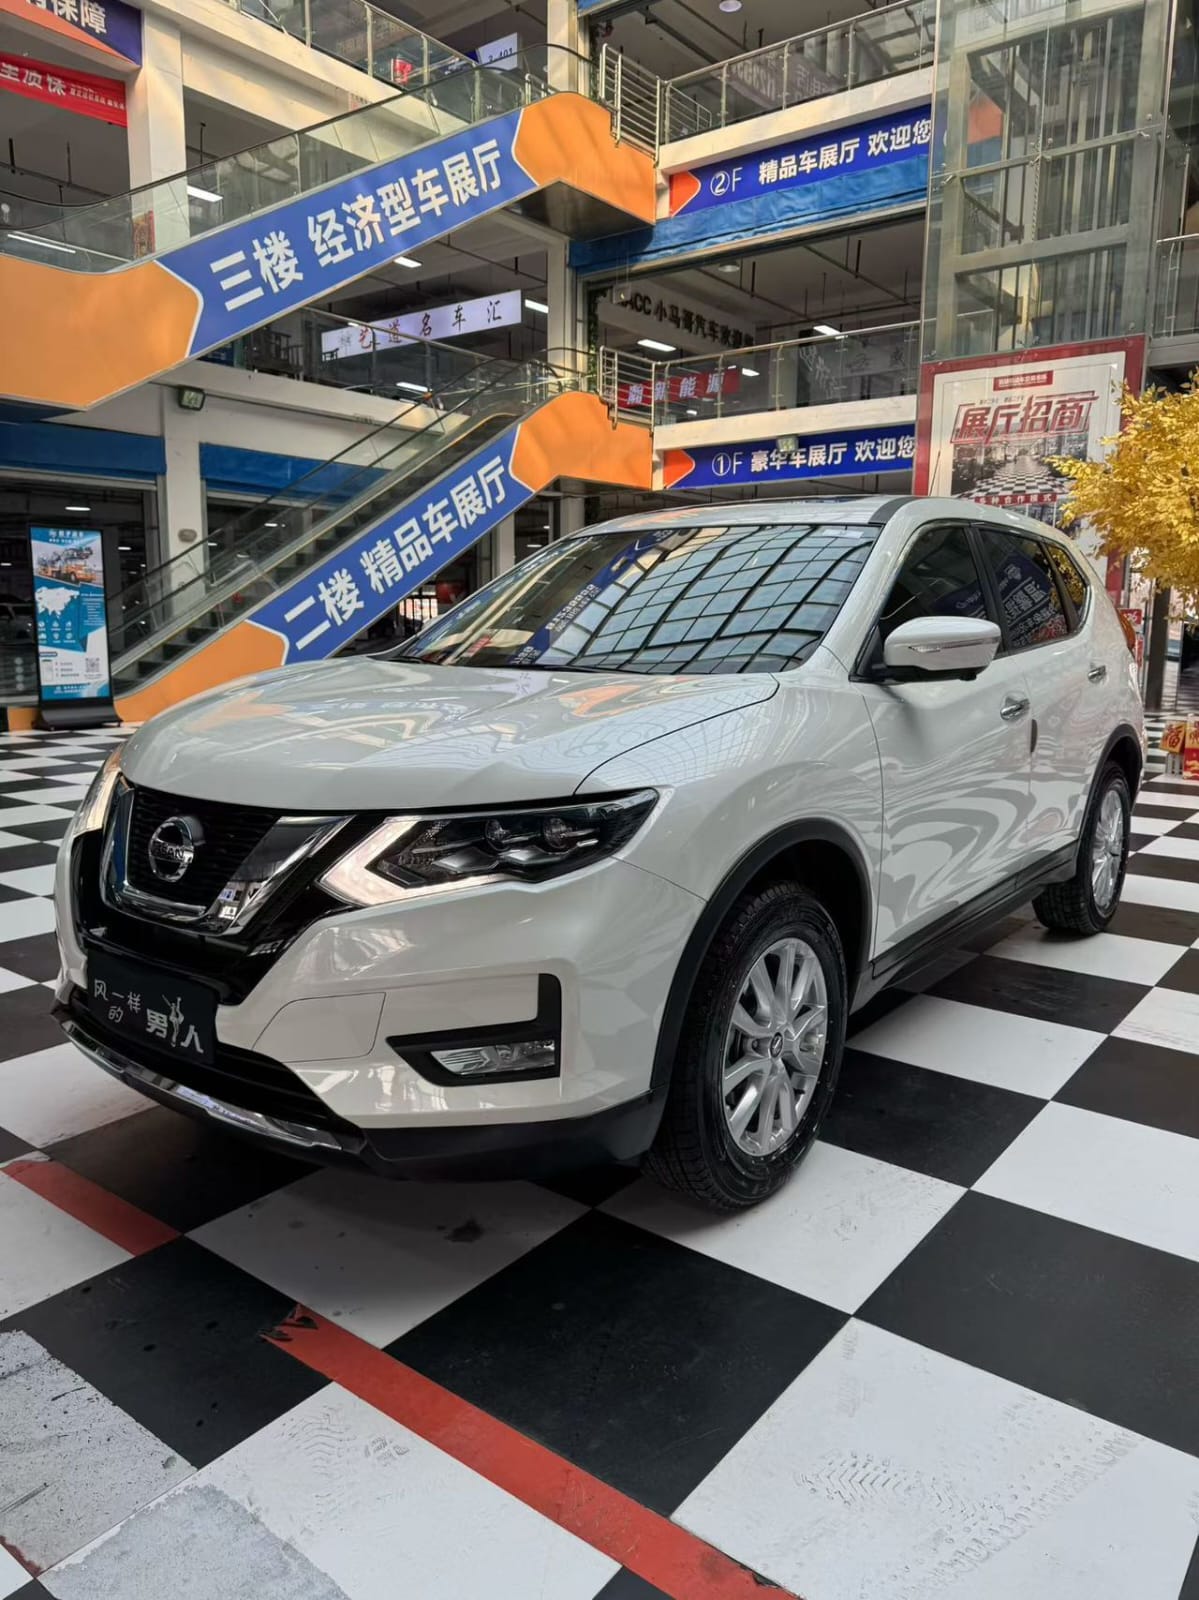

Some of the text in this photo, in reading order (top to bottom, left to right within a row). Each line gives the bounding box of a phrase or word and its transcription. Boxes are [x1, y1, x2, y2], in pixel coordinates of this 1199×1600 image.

[758, 138, 861, 186] 精品车展厅
[867, 119, 932, 157] 欢迎您
[210, 138, 501, 312] 三楼 经济型车展厅
[958, 394, 1099, 445] 展厅招商
[751, 442, 848, 473] 豪华车展厅
[854, 436, 915, 462] 欢迎您
[284, 455, 505, 650] 二楼 精品车展厅
[94, 979, 141, 1014] 风一样
[108, 1005, 124, 1023] 的
[146, 1008, 204, 1054] 男人
